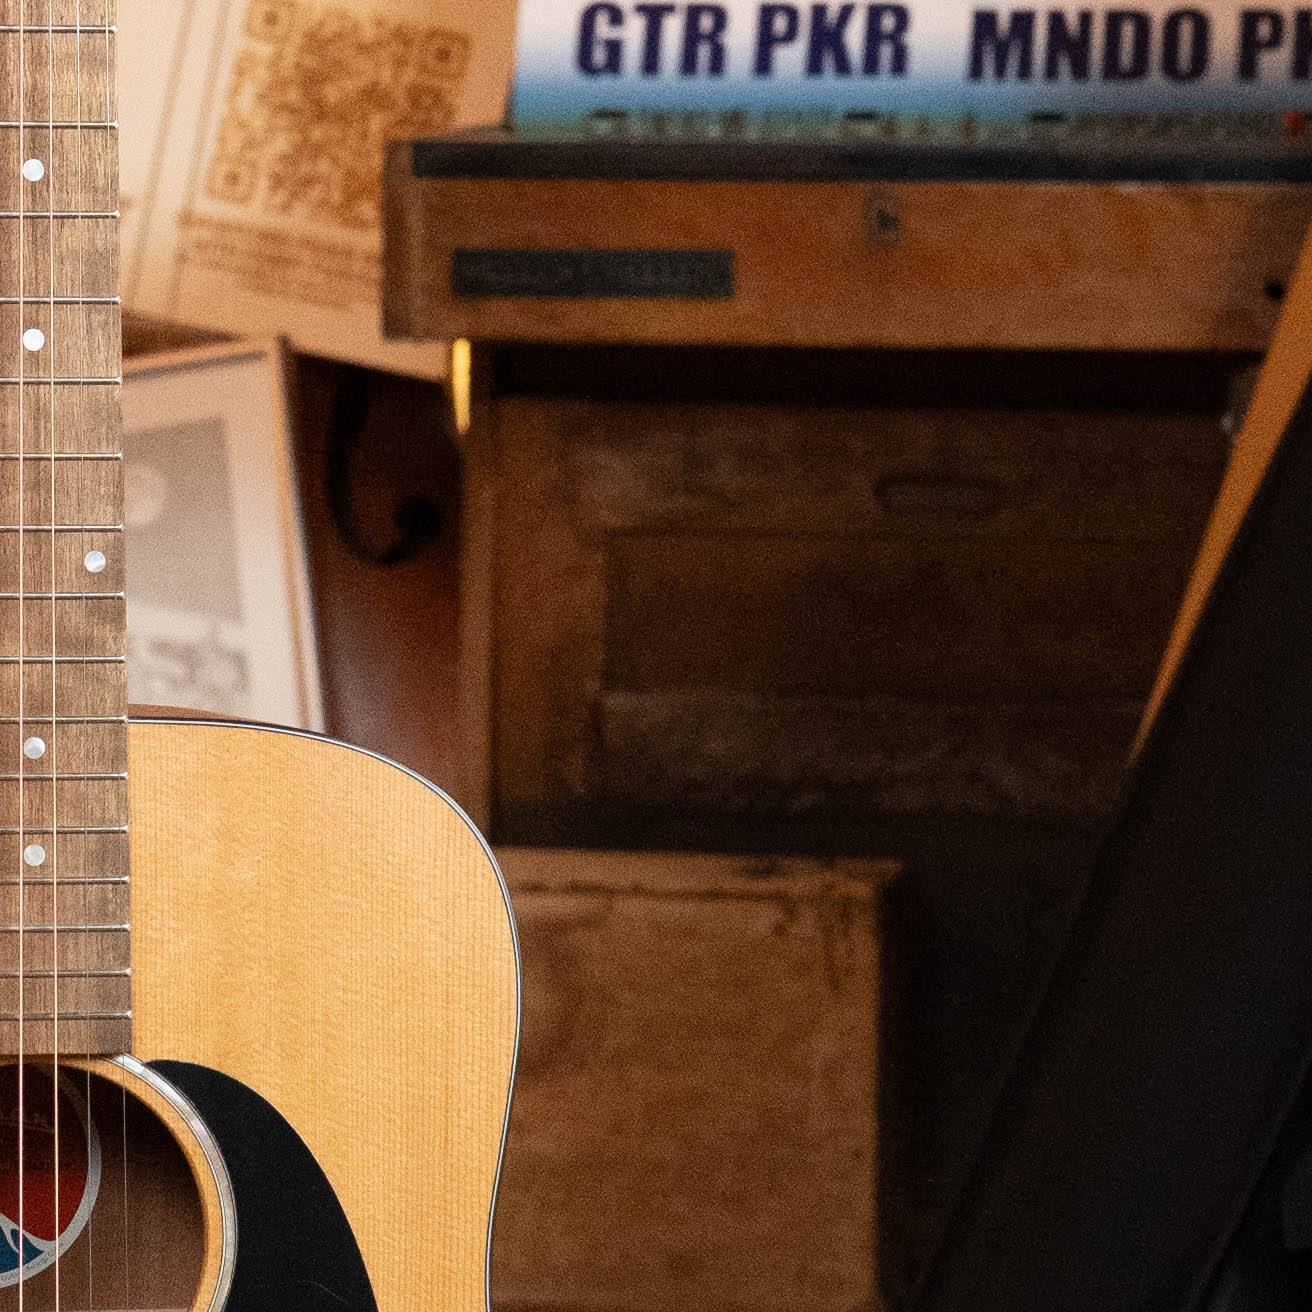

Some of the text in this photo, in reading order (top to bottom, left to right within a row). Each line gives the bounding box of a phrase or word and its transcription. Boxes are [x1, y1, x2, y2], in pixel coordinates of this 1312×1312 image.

[577, 0, 911, 79] GTR PKR
[966, 7, 1212, 82] MNDO
